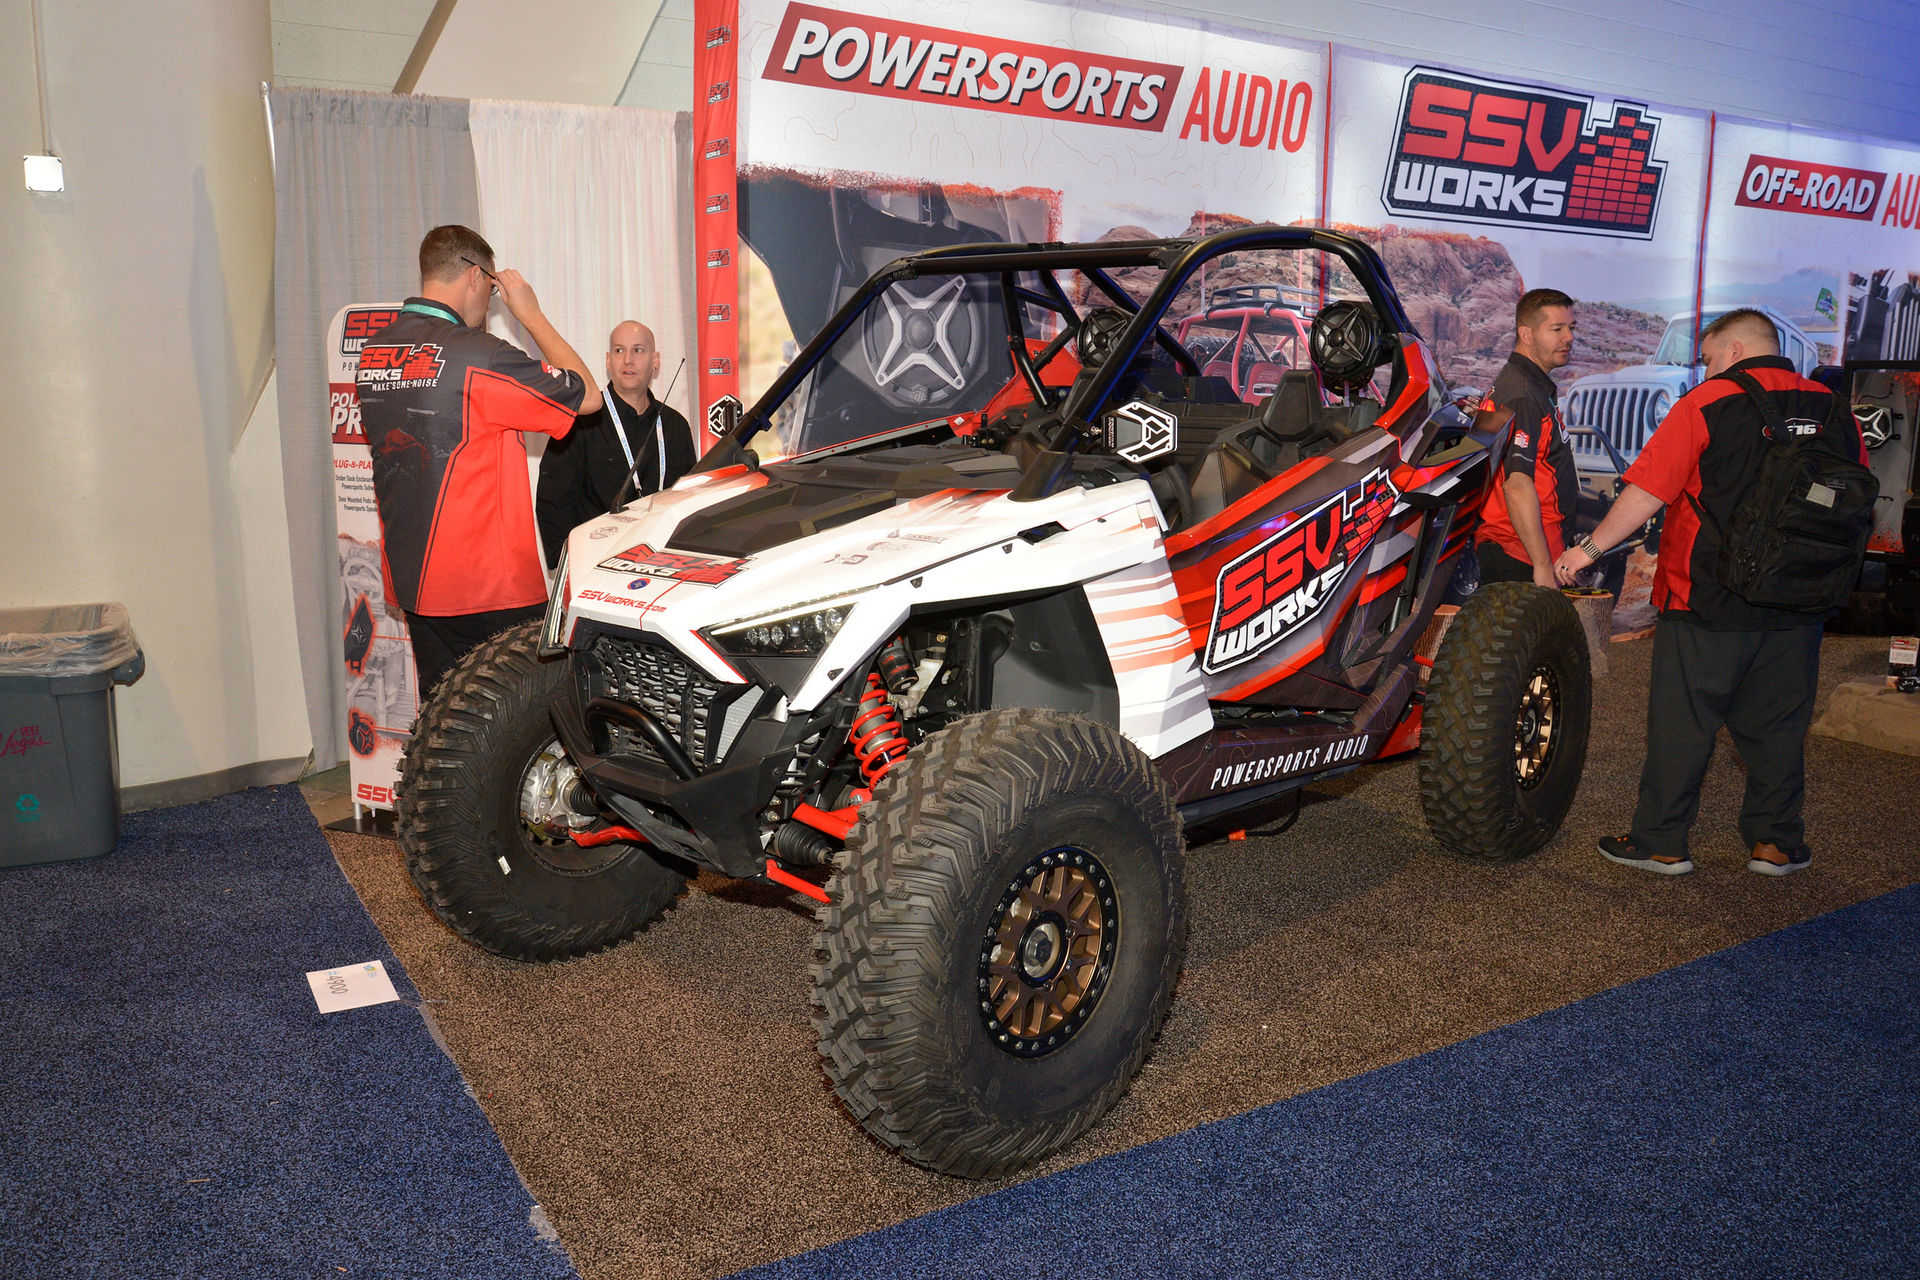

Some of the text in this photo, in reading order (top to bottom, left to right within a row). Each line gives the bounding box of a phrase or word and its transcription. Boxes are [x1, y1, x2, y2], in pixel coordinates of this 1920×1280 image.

[782, 18, 1313, 153] POWERSPORTS AUDIO
[1402, 82, 1581, 172] SSV
[1393, 161, 1567, 218] WORKS
[1745, 163, 1920, 229] OFF-ROAD AU
[360, 347, 411, 368] SSV
[331, 392, 361, 408] POL
[332, 406, 363, 435] PR
[600, 558, 682, 577] WORKS
[1219, 506, 1341, 632] SSV
[1212, 561, 1345, 664] WORKS
[1211, 734, 1370, 790] POWERSPORTS AUDIO
[326, 975, 349, 995] 4900
